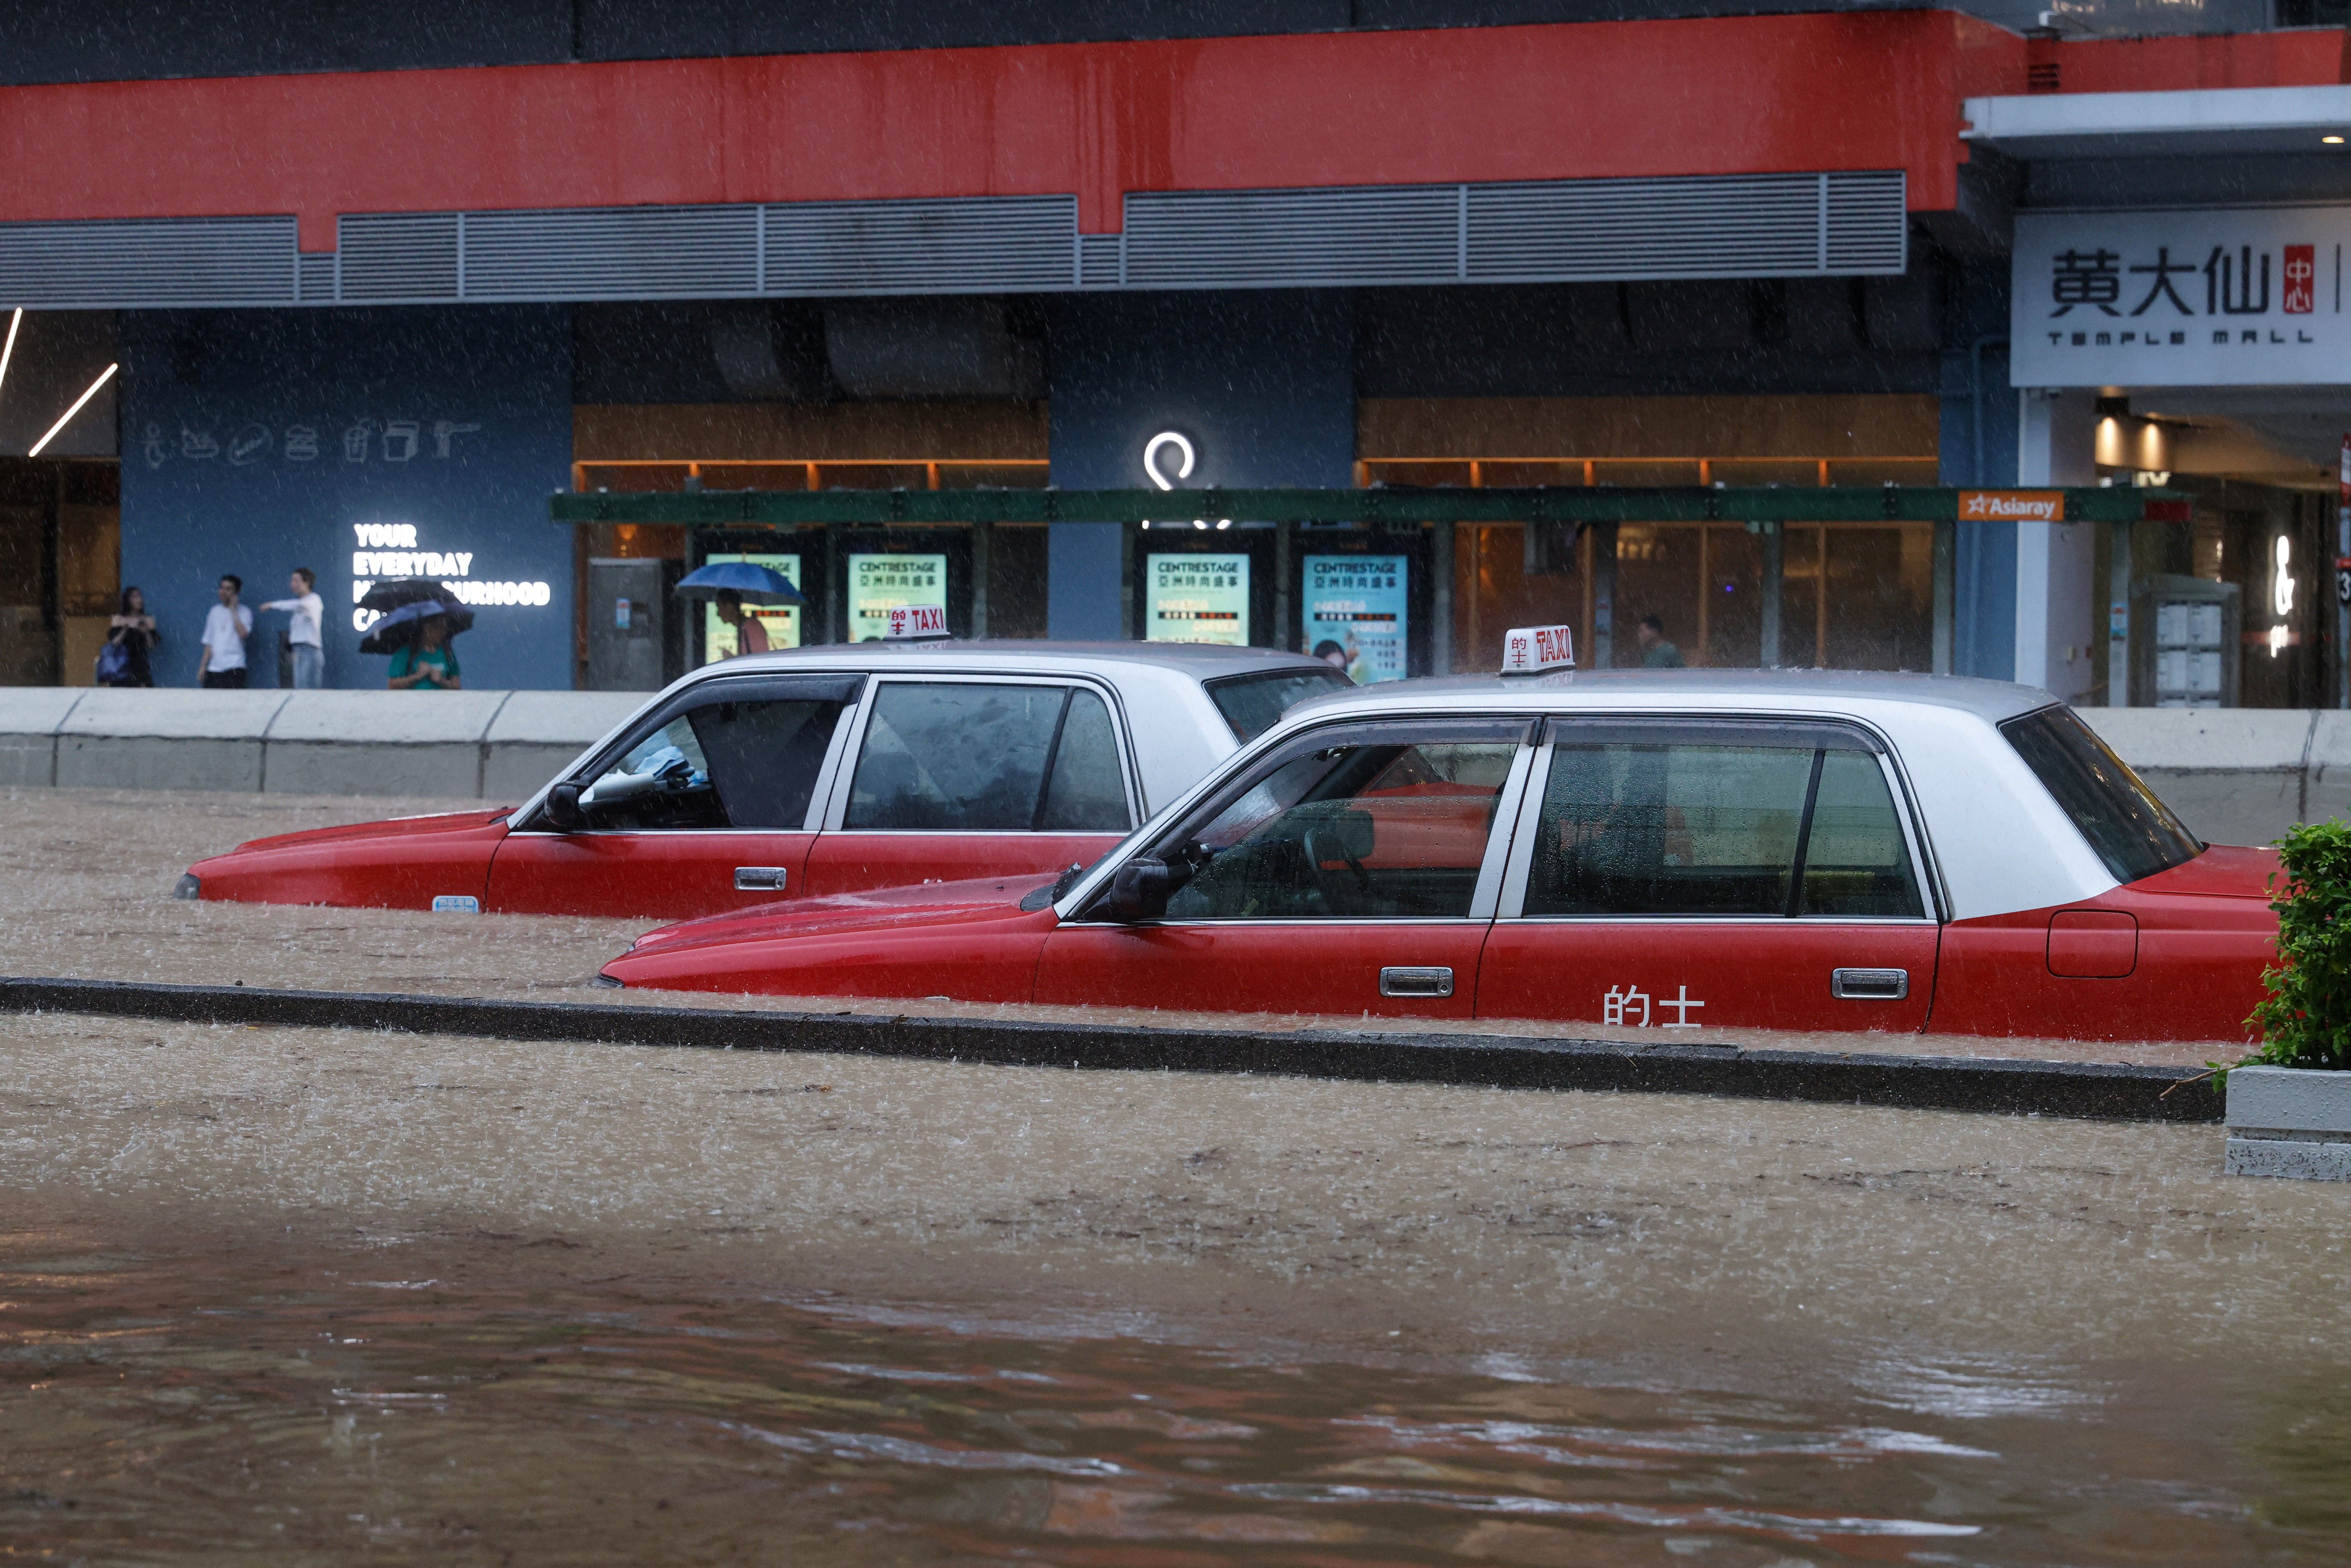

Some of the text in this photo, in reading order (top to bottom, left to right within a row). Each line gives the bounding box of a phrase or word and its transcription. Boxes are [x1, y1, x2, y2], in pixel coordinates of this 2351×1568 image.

[2286, 257, 2310, 312] 中心
[2048, 329, 2313, 345] TEMPLE MALL
[1989, 497, 2055, 520] Asiaray
[354, 524, 417, 548] YOUR
[353, 552, 473, 576] EVERYDAY
[859, 562, 936, 572] CENTRESTAGE
[1158, 562, 1238, 573] CENTRESTAGE
[1313, 562, 1396, 574] CENTRESTAGE
[891, 610, 906, 631] 的士
[912, 608, 944, 631] TAXI
[1511, 637, 1527, 663] 的士
[1536, 628, 1570, 662] TAXI
[1604, 985, 1705, 1028] 的士
